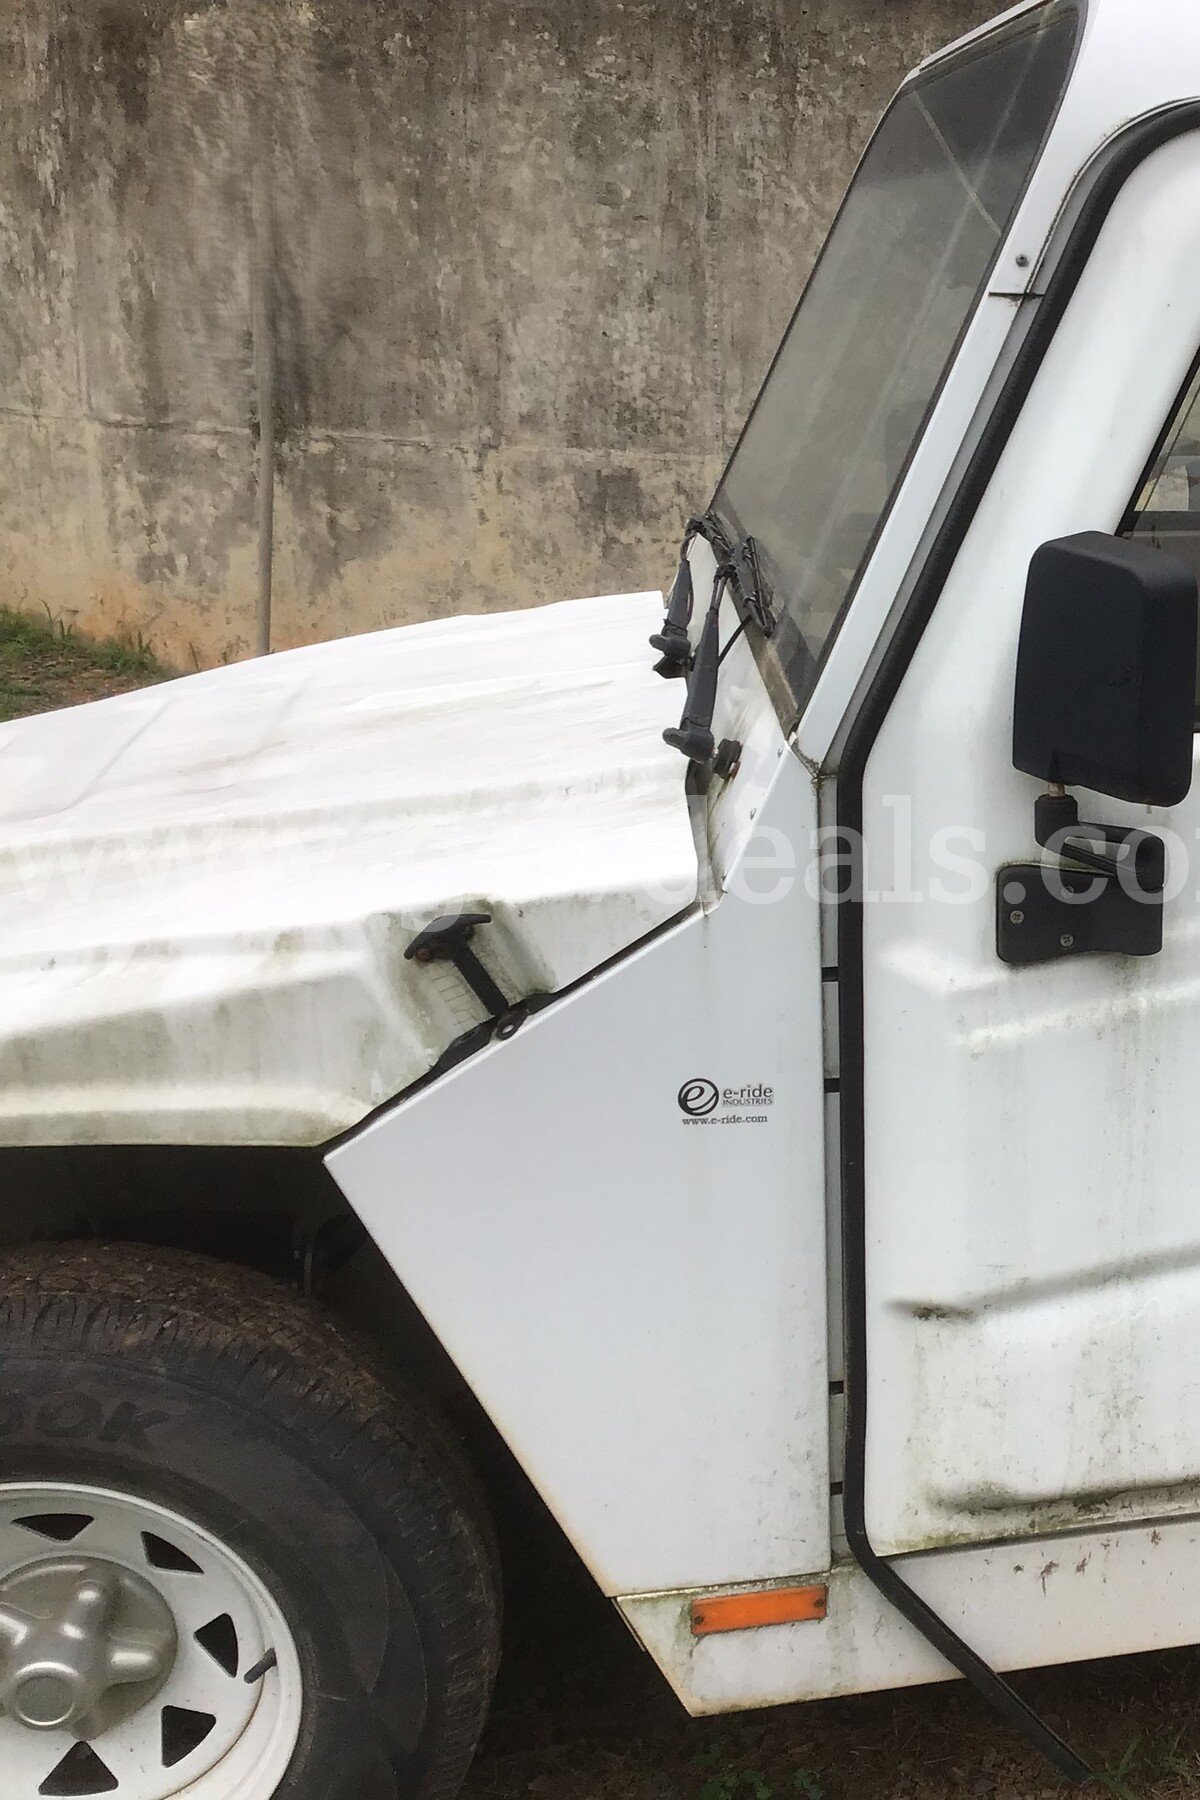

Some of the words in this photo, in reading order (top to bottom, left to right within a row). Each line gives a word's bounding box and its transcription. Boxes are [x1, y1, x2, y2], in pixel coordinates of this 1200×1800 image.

[723, 1083, 773, 1099] e-ride
[723, 1097, 773, 1107] INDUSTRIES
[682, 1114, 768, 1125] www.e-ride.com
